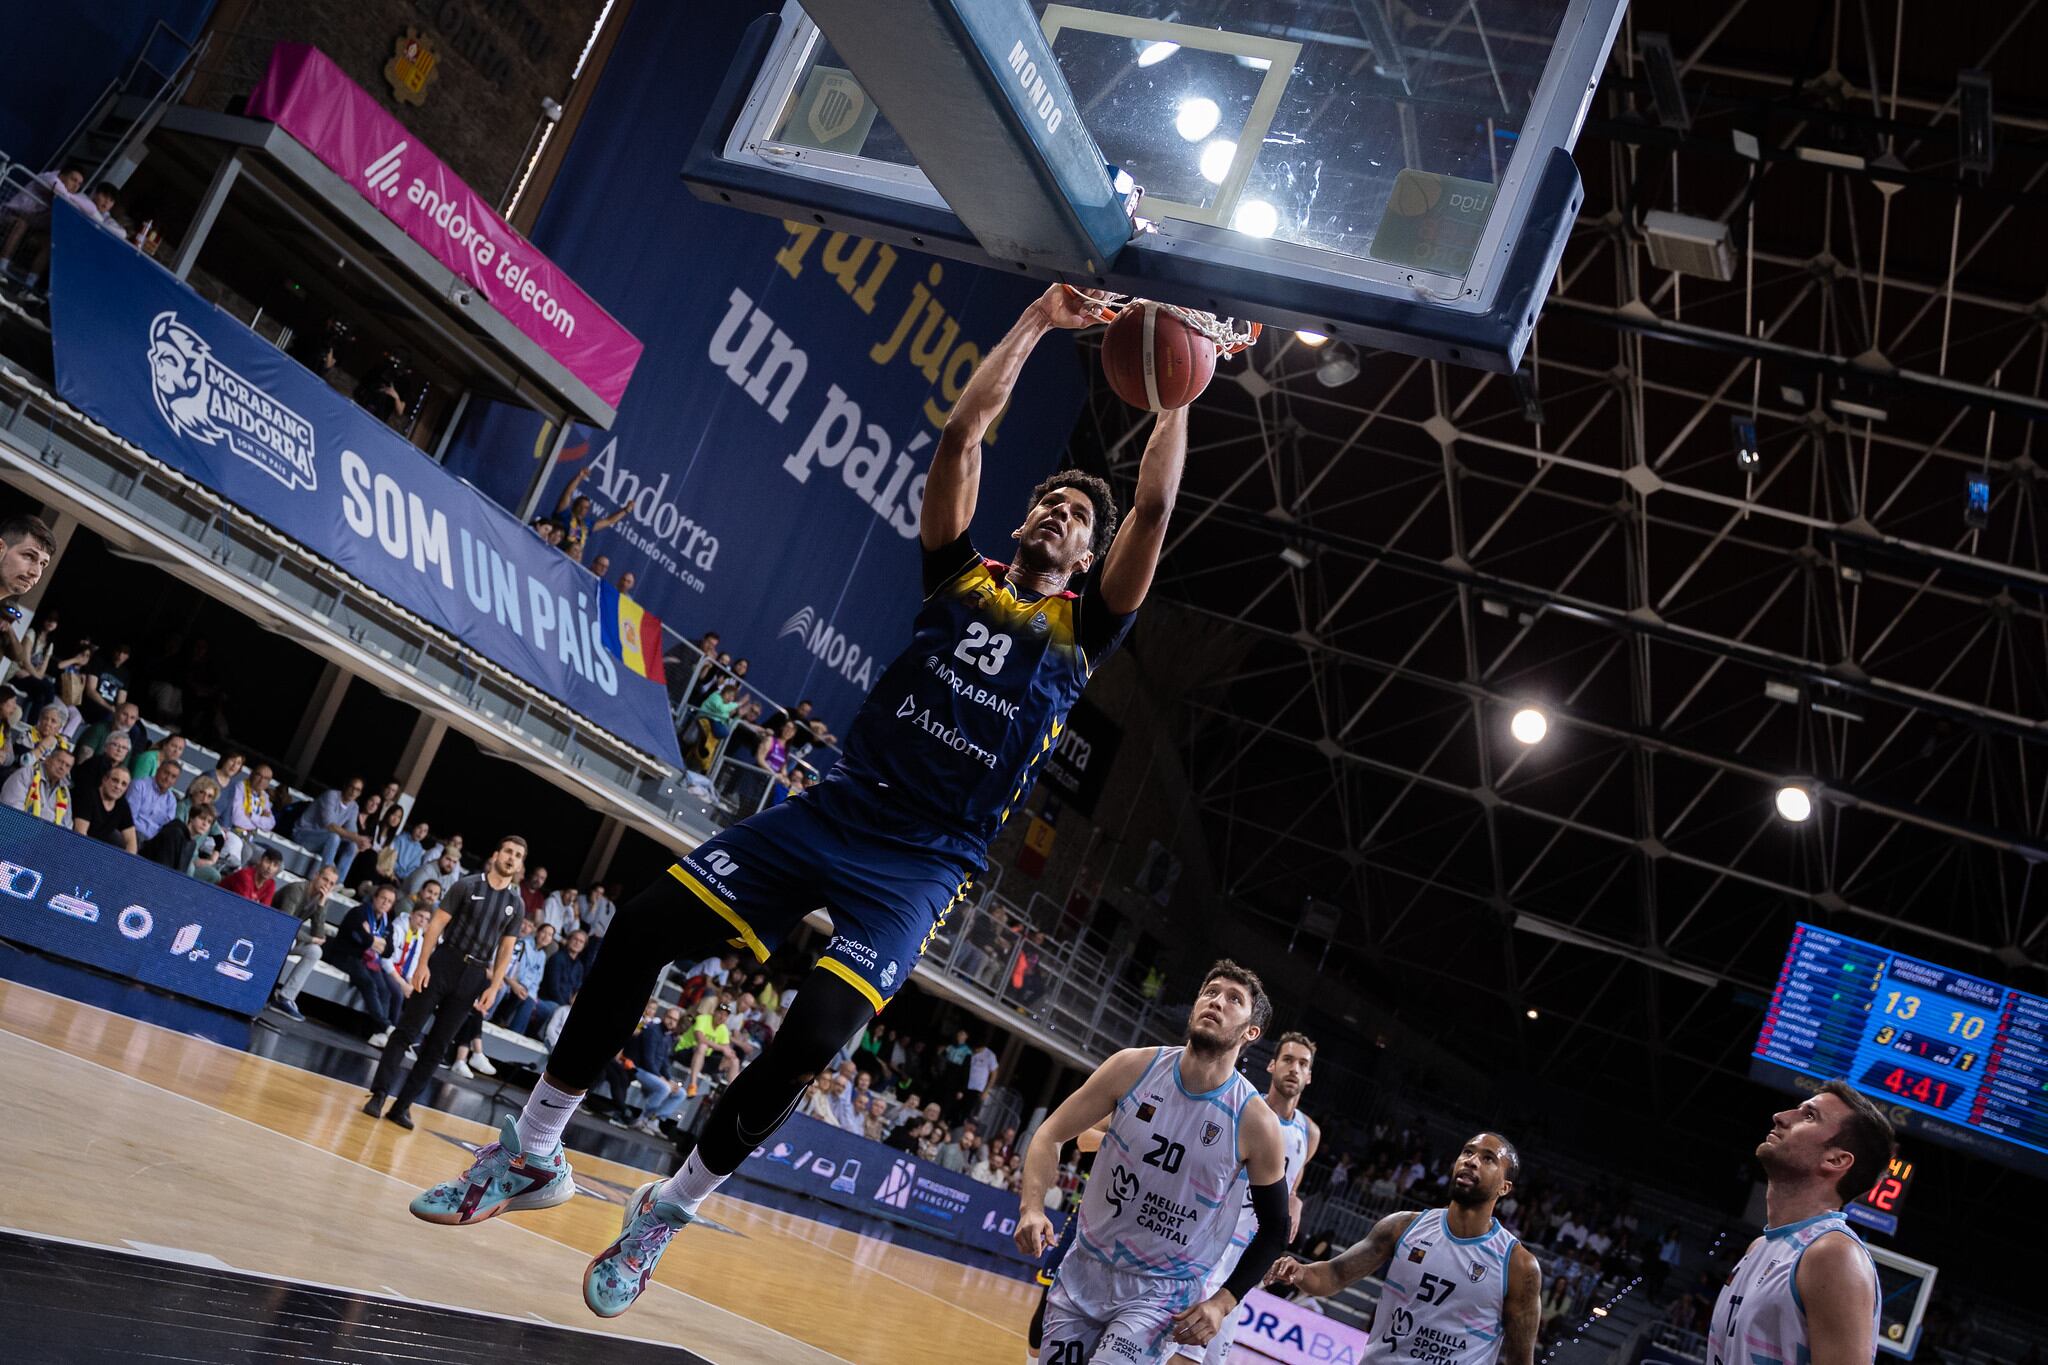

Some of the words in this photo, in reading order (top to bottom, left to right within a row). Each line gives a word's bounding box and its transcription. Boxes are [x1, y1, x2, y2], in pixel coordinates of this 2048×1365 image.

[1008, 40, 1062, 134] MONDO
[407, 178, 495, 265] andorra
[496, 252, 575, 338] telecom
[869, 263, 1011, 446] jug
[208, 364, 308, 445] MORABANC
[709, 287, 808, 424] un
[783, 383, 932, 539] país
[210, 389, 311, 479] ANDORRA
[585, 435, 719, 571] Andorra
[340, 450, 454, 590] SOM
[460, 528, 522, 636] UN
[954, 621, 1013, 676] 23
[912, 708, 997, 769] Andorra
[1884, 991, 1921, 1020] 13
[1948, 1011, 1985, 1040] 10
[1884, 1067, 1948, 1107] 4:41
[1142, 1133, 1186, 1174] 20
[1144, 1191, 1198, 1221] MELILLA
[1867, 1179, 1902, 1211] 12
[1136, 1215, 1188, 1246] CAPITAL
[1140, 1203, 1184, 1228] SPORT
[1416, 1272, 1456, 1306] 57
[1047, 1340, 1084, 1365] 20
[1113, 1340, 1137, 1355] SPORT
[1116, 1336, 1142, 1354] MELILLA
[1413, 1338, 1455, 1357] SPORT
[1417, 1325, 1467, 1350] MELILLA
[1111, 1346, 1137, 1364] CAPITAL
